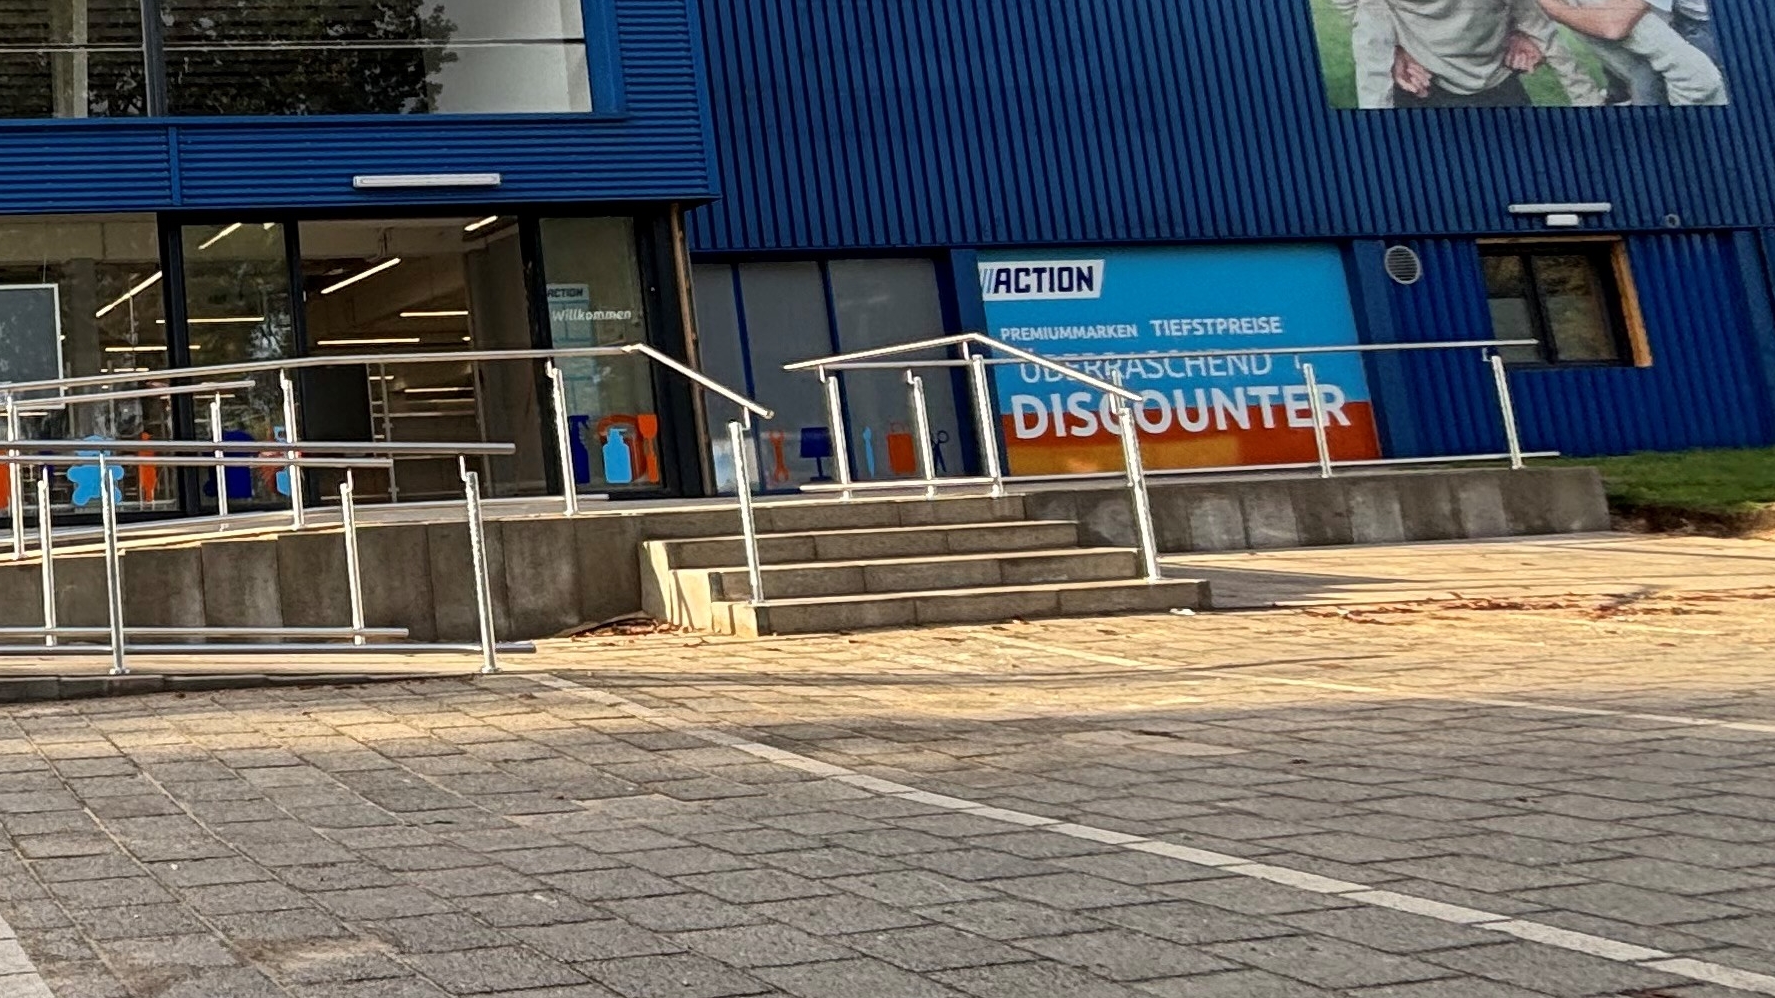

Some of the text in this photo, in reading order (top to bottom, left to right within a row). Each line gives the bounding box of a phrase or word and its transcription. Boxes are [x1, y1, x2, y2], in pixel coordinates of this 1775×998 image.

[993, 265, 1094, 294] ACTION
[552, 308, 632, 321] Willkommen
[1000, 316, 1284, 341] PREMIUMMARKEN TIEFSTPREISE
[1010, 383, 1353, 439] DISCOUNTER
